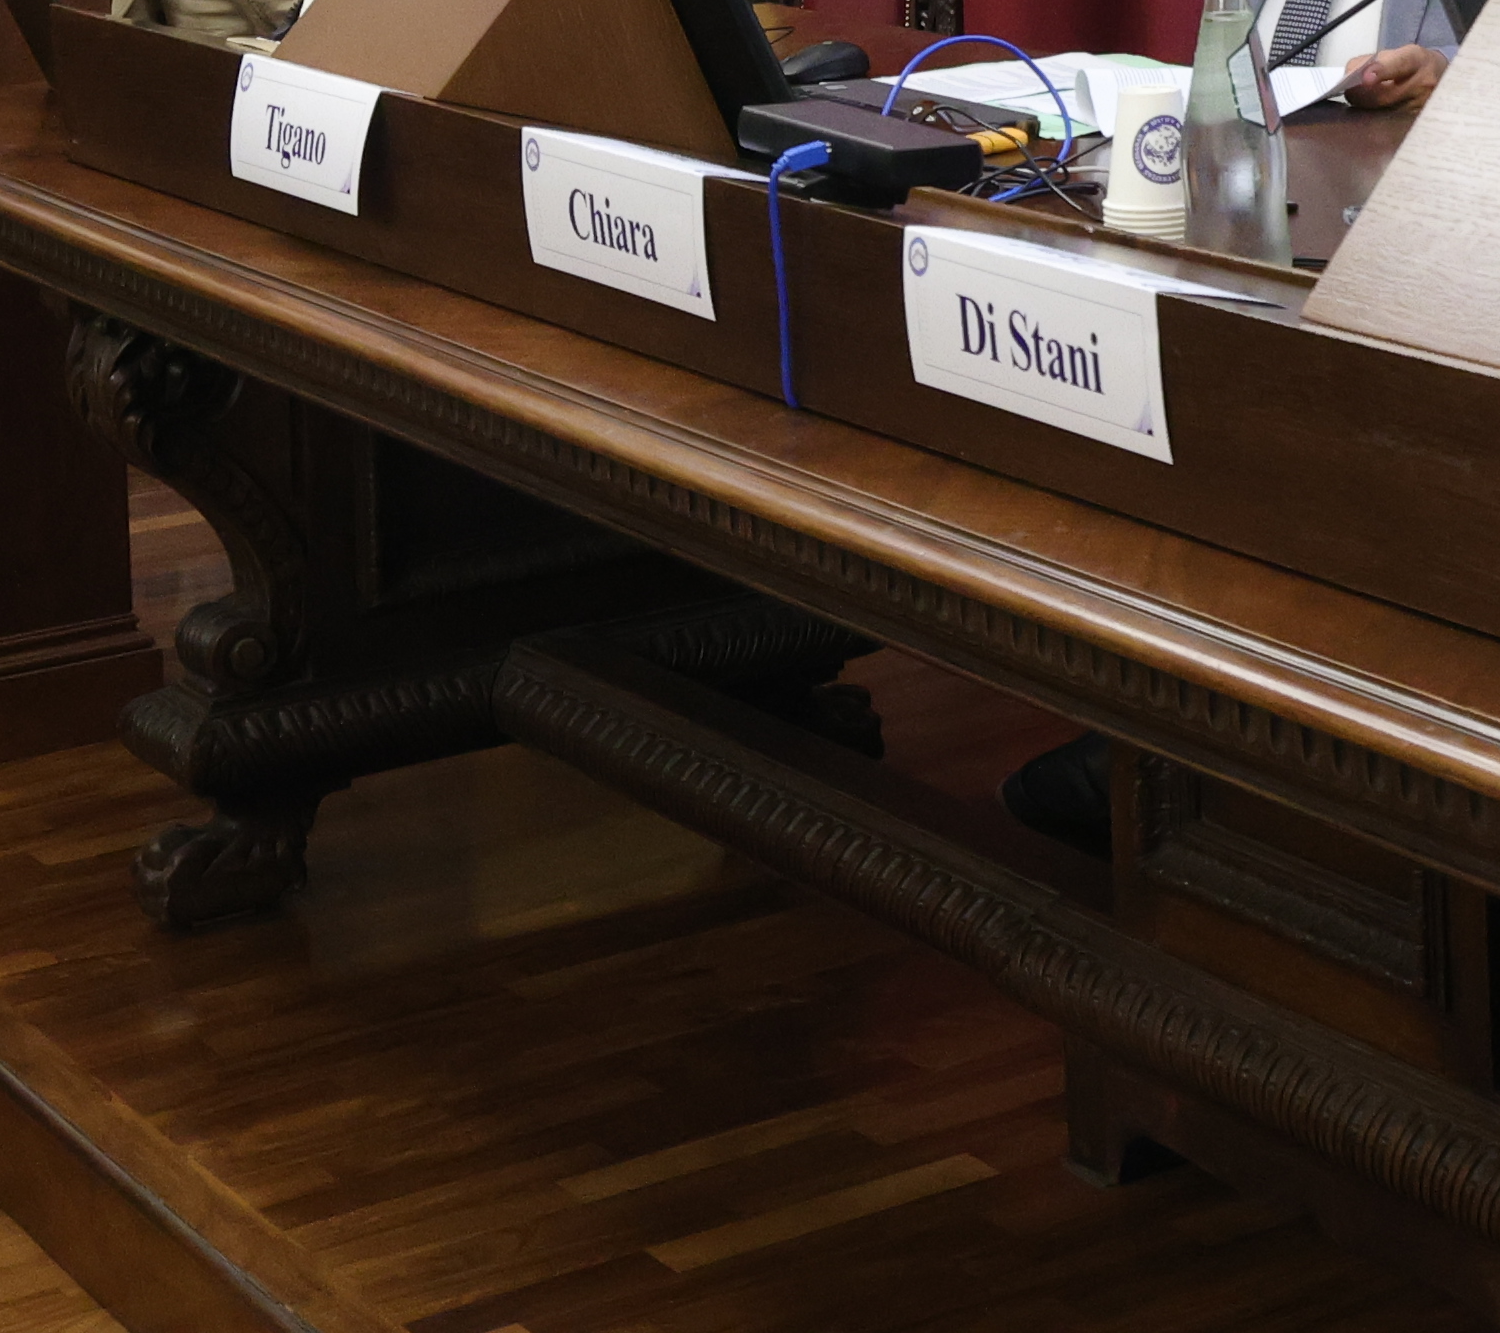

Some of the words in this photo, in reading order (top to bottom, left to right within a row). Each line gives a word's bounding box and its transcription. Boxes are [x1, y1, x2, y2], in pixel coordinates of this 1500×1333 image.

[265, 104, 326, 169] Tigano
[569, 188, 658, 263] Chiara
[956, 293, 1001, 363] Di
[1009, 309, 1105, 395] Stani
